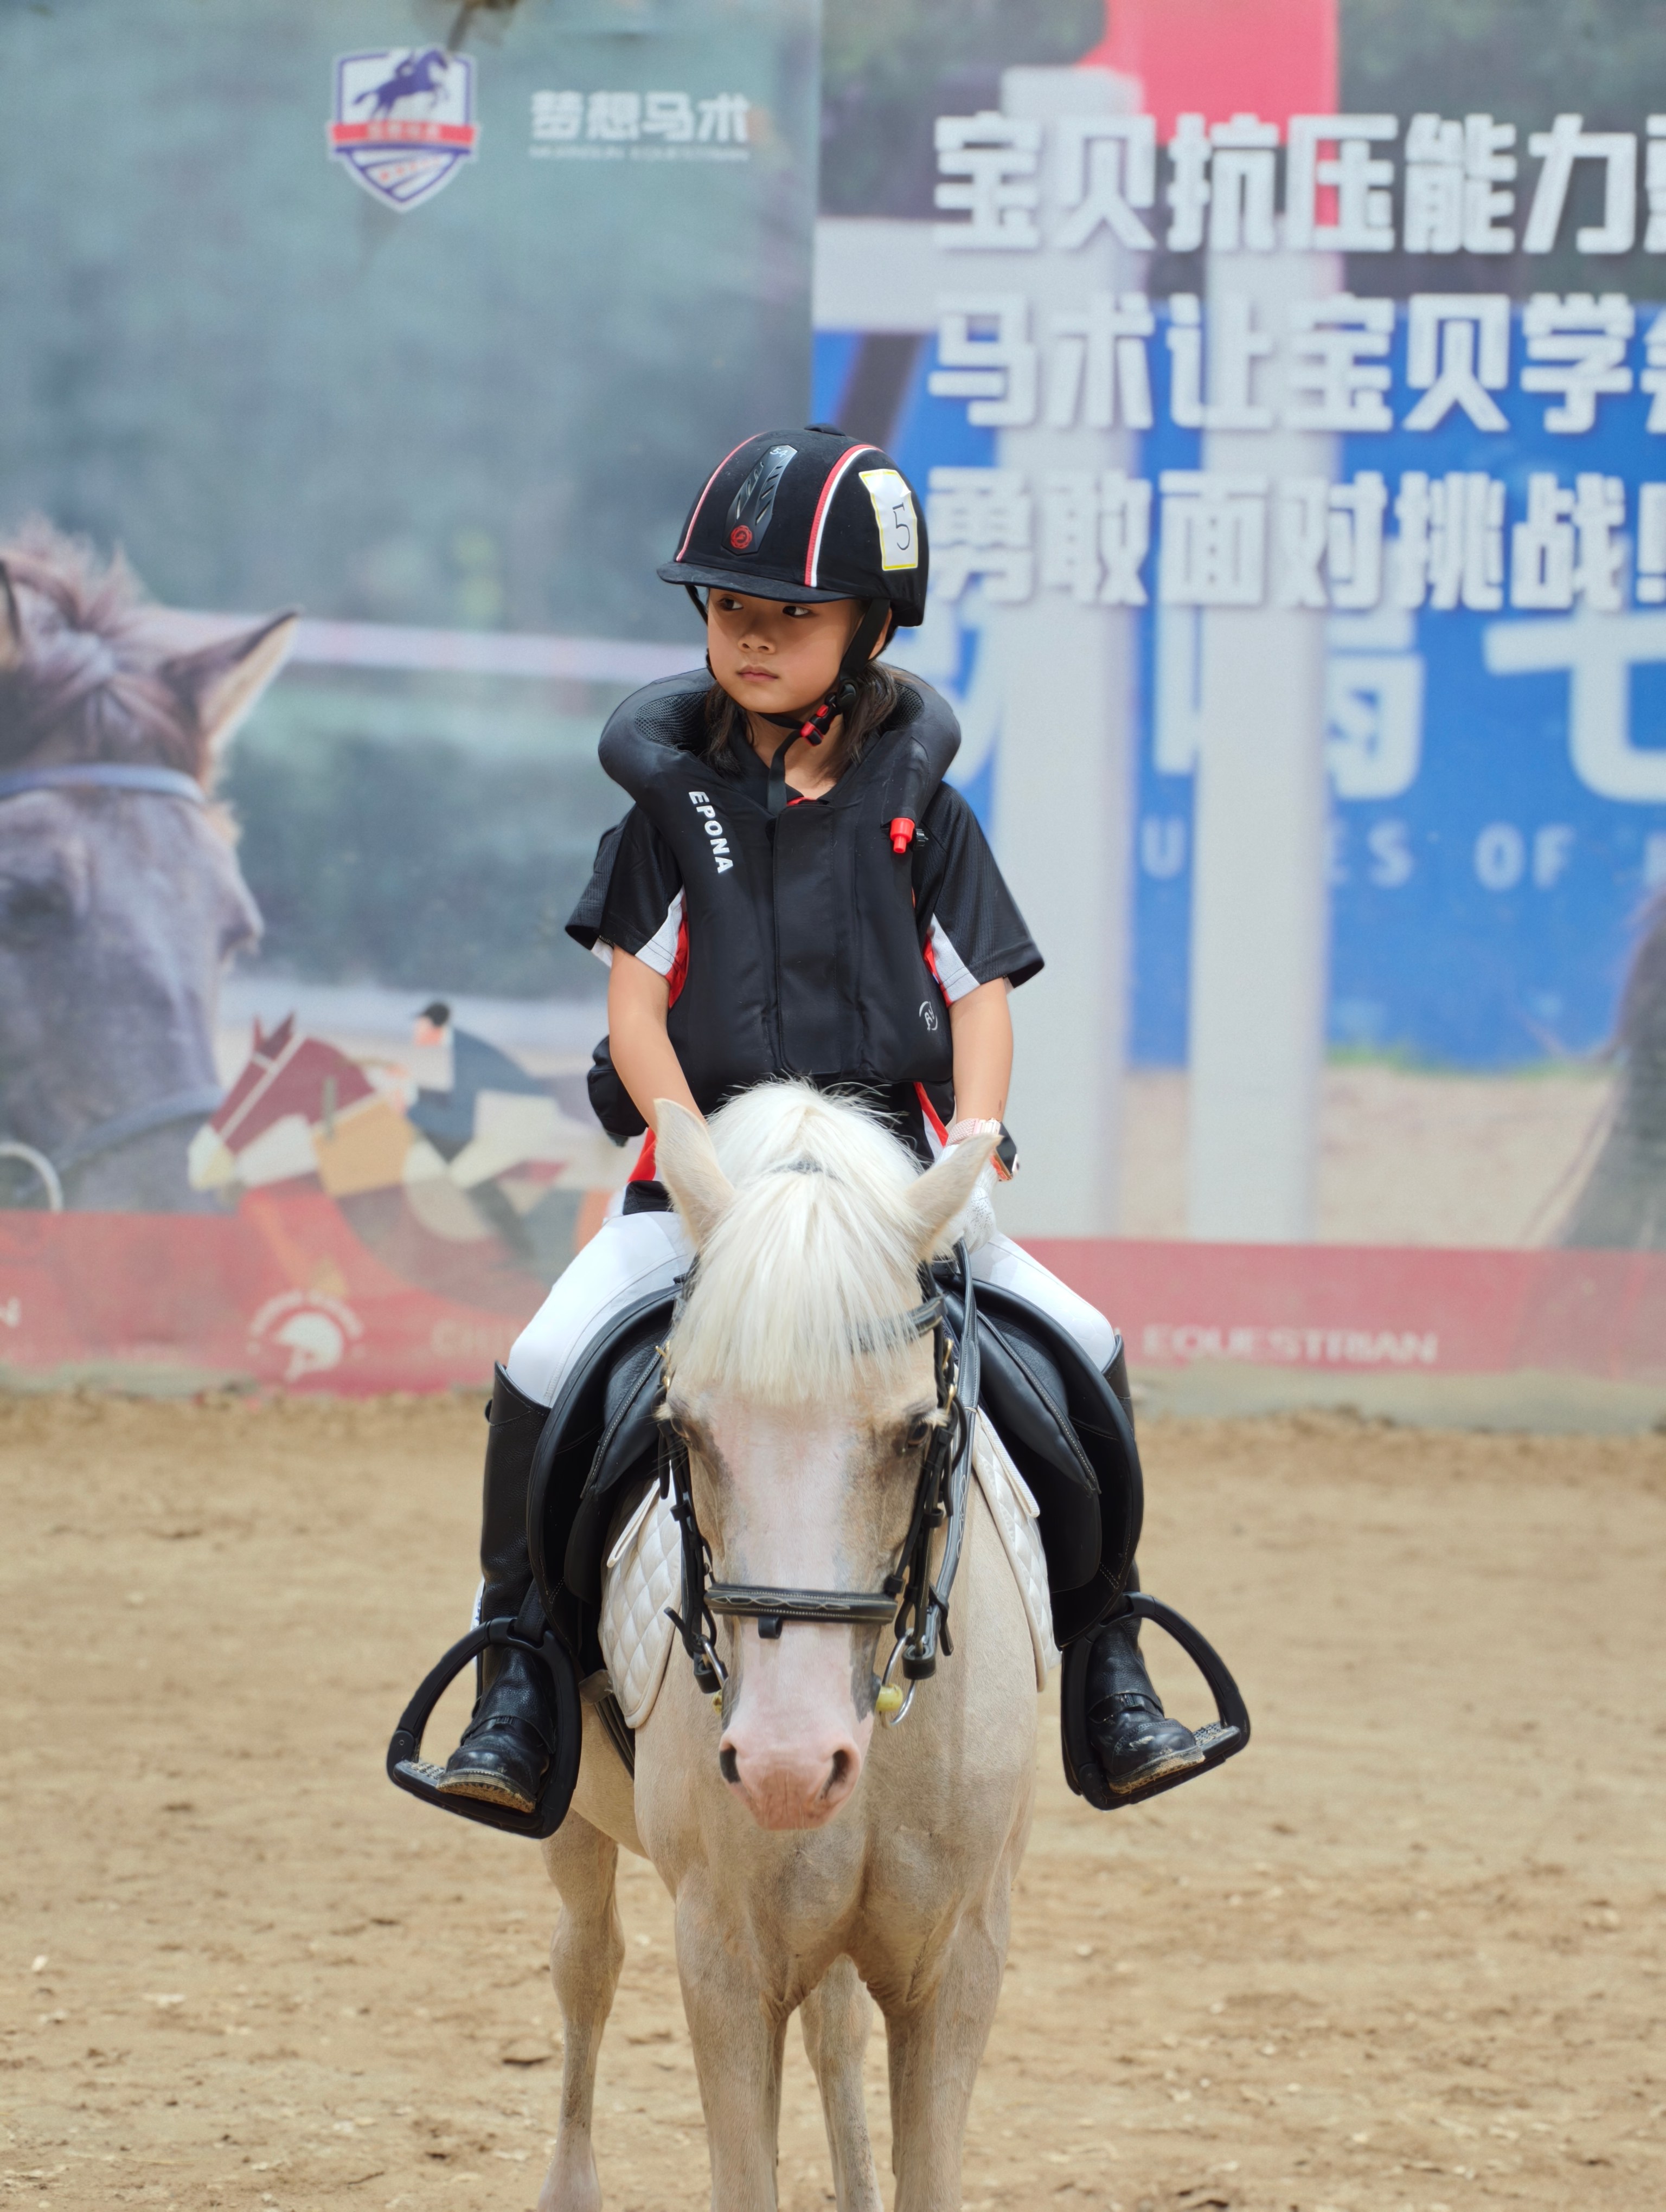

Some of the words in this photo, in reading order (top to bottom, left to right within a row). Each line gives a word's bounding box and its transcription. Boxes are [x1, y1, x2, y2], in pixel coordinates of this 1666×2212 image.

[531, 89, 749, 142] 梦想马术
[934, 112, 1666, 253] 宝贝抗压能力
[928, 292, 1666, 433] 马术让宝贝学
[770, 447, 788, 457] 54
[892, 502, 911, 550] 5
[689, 792, 733, 873] EPONA
[1143, 1323, 1439, 1365] EQUESTRIAN
